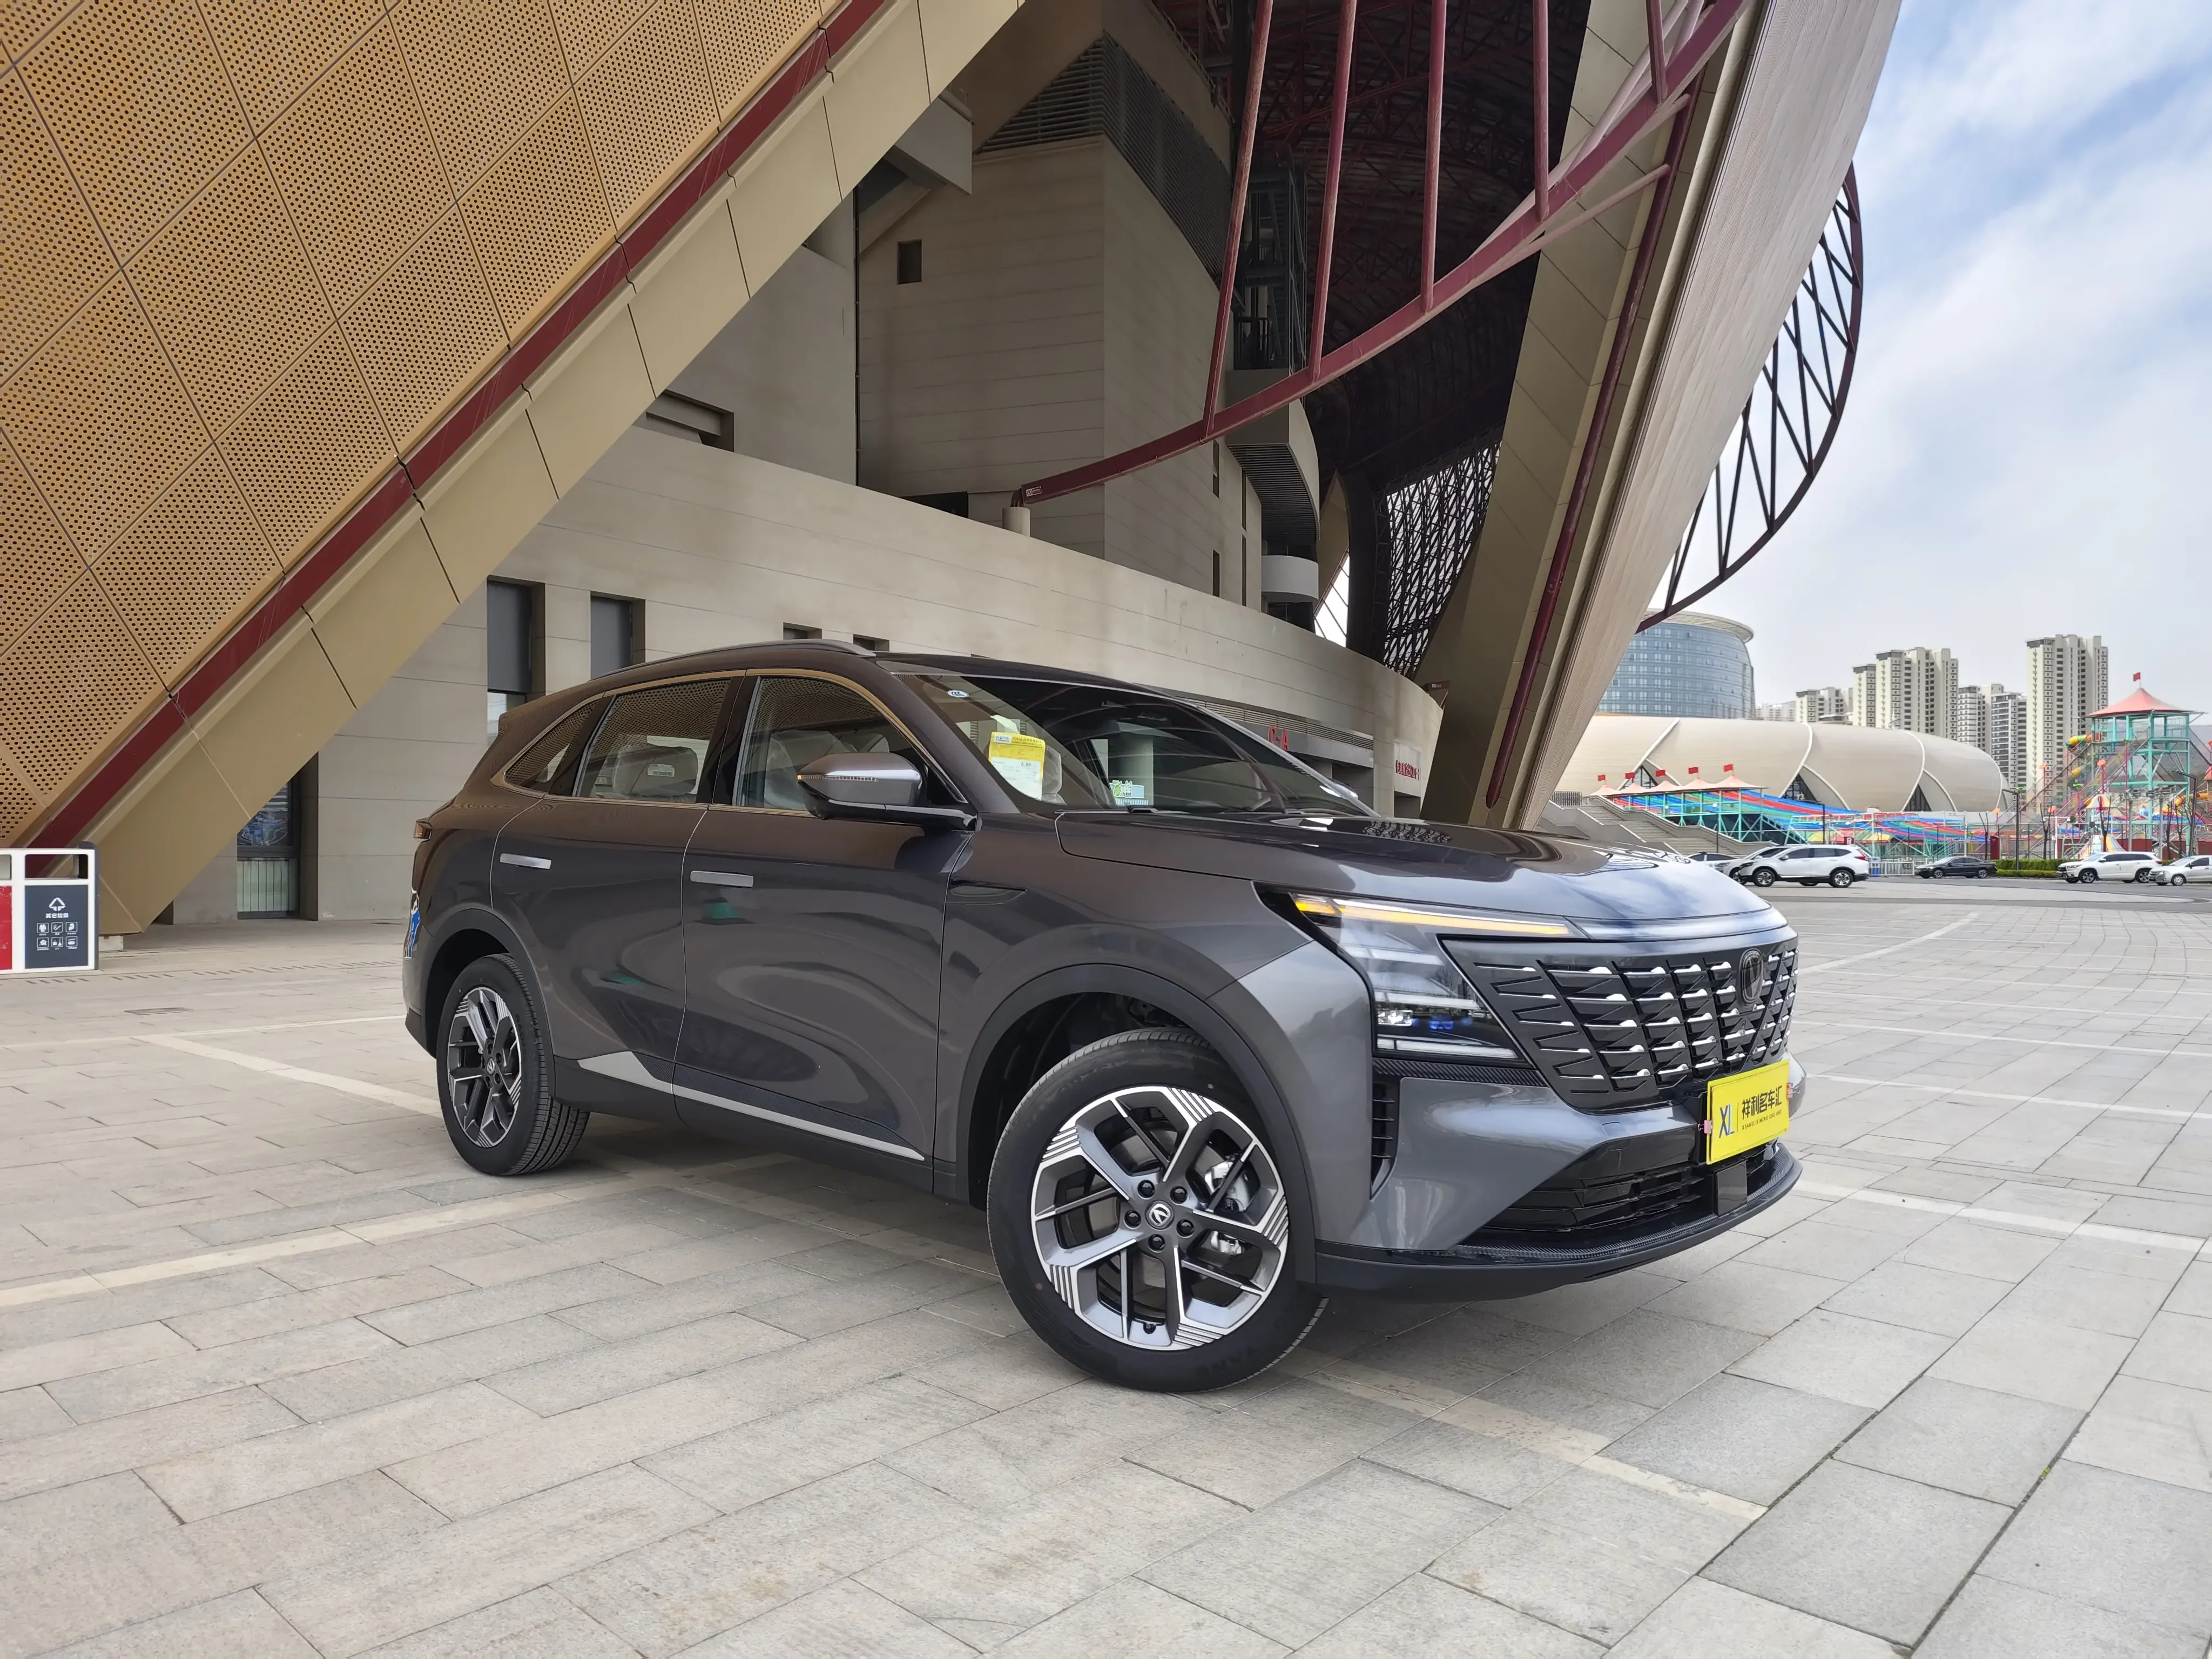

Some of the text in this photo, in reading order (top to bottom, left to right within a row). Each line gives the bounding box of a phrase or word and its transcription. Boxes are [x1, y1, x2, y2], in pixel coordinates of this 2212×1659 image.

[1742, 1085, 1783, 1120] 祥利名车汇
[1719, 1104, 1735, 1138] XL
